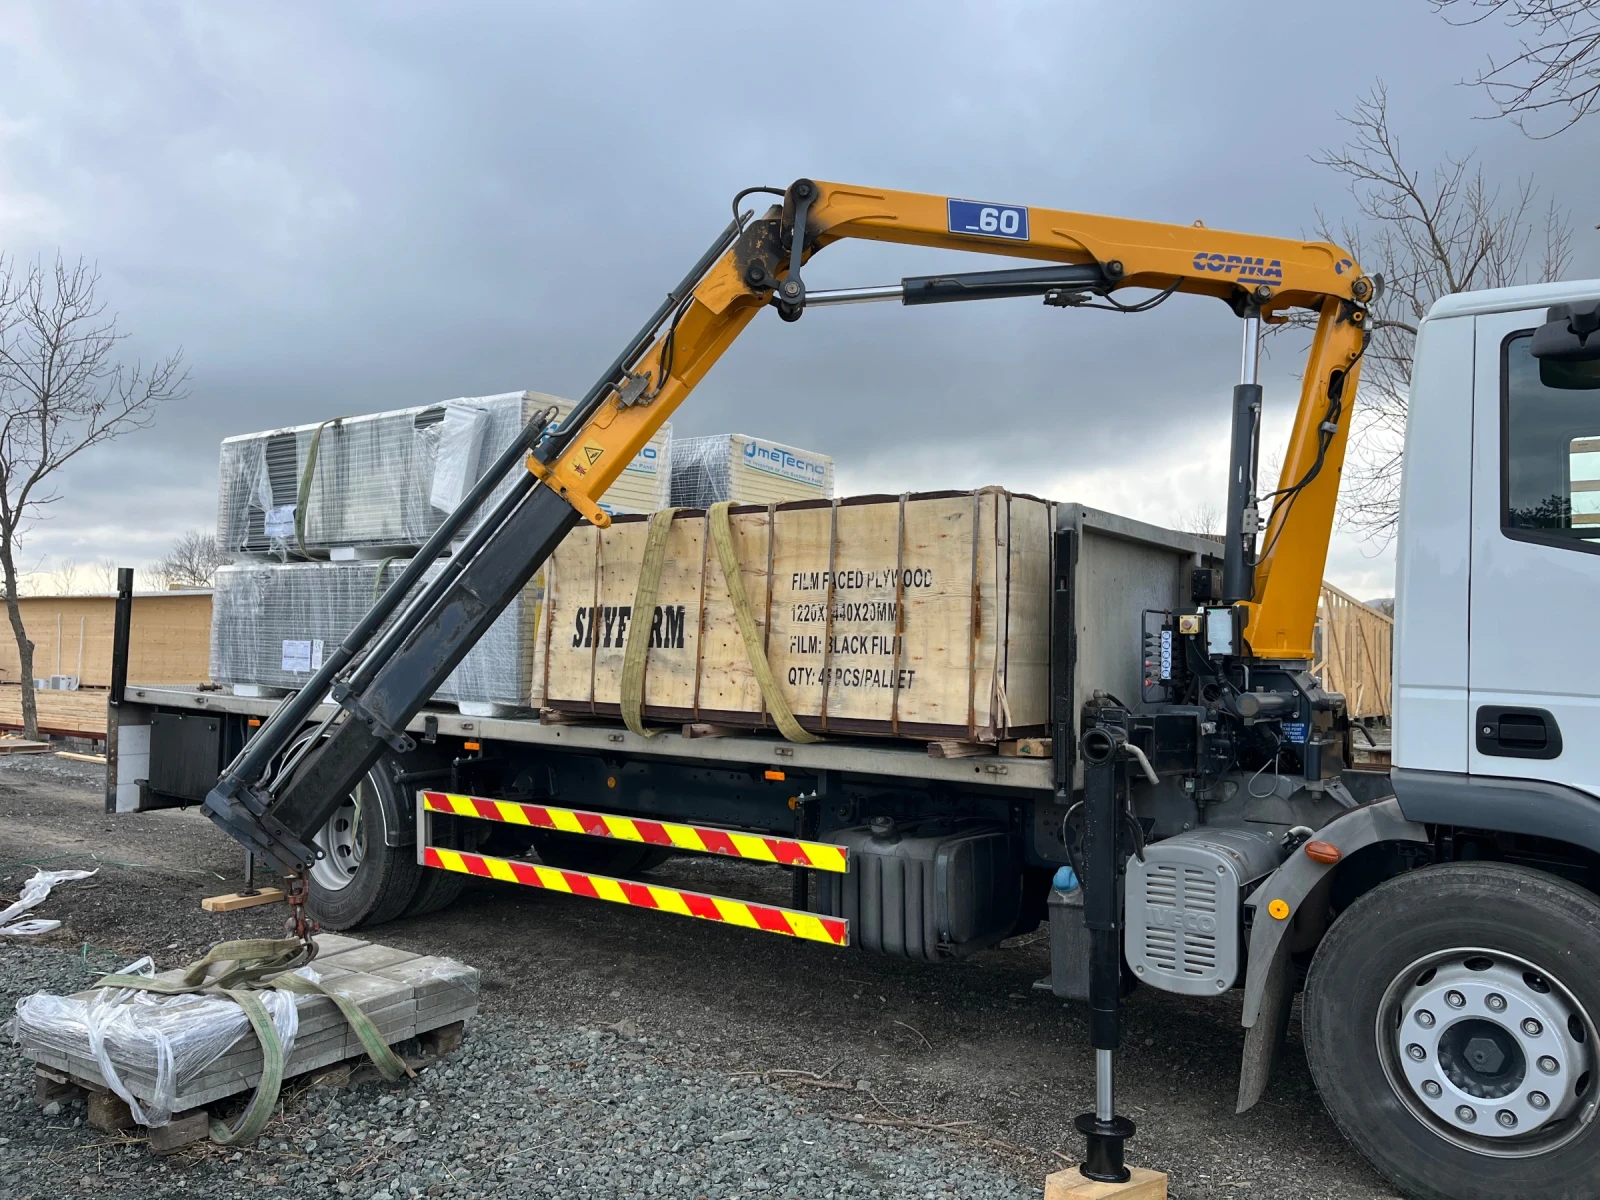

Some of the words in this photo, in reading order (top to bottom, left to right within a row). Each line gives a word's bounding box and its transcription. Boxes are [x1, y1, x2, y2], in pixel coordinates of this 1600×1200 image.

[1193, 252, 1283, 278] COPMA
[792, 571, 819, 590] FILM
[791, 602, 898, 622] 1220X440X20MM
[572, 604, 686, 649] SKYFRM
[789, 635, 821, 654] FILM:
[788, 667, 815, 686] QTY:
[835, 668, 916, 689] PCS/PALLET
[1146, 907, 1217, 933] IVECO
